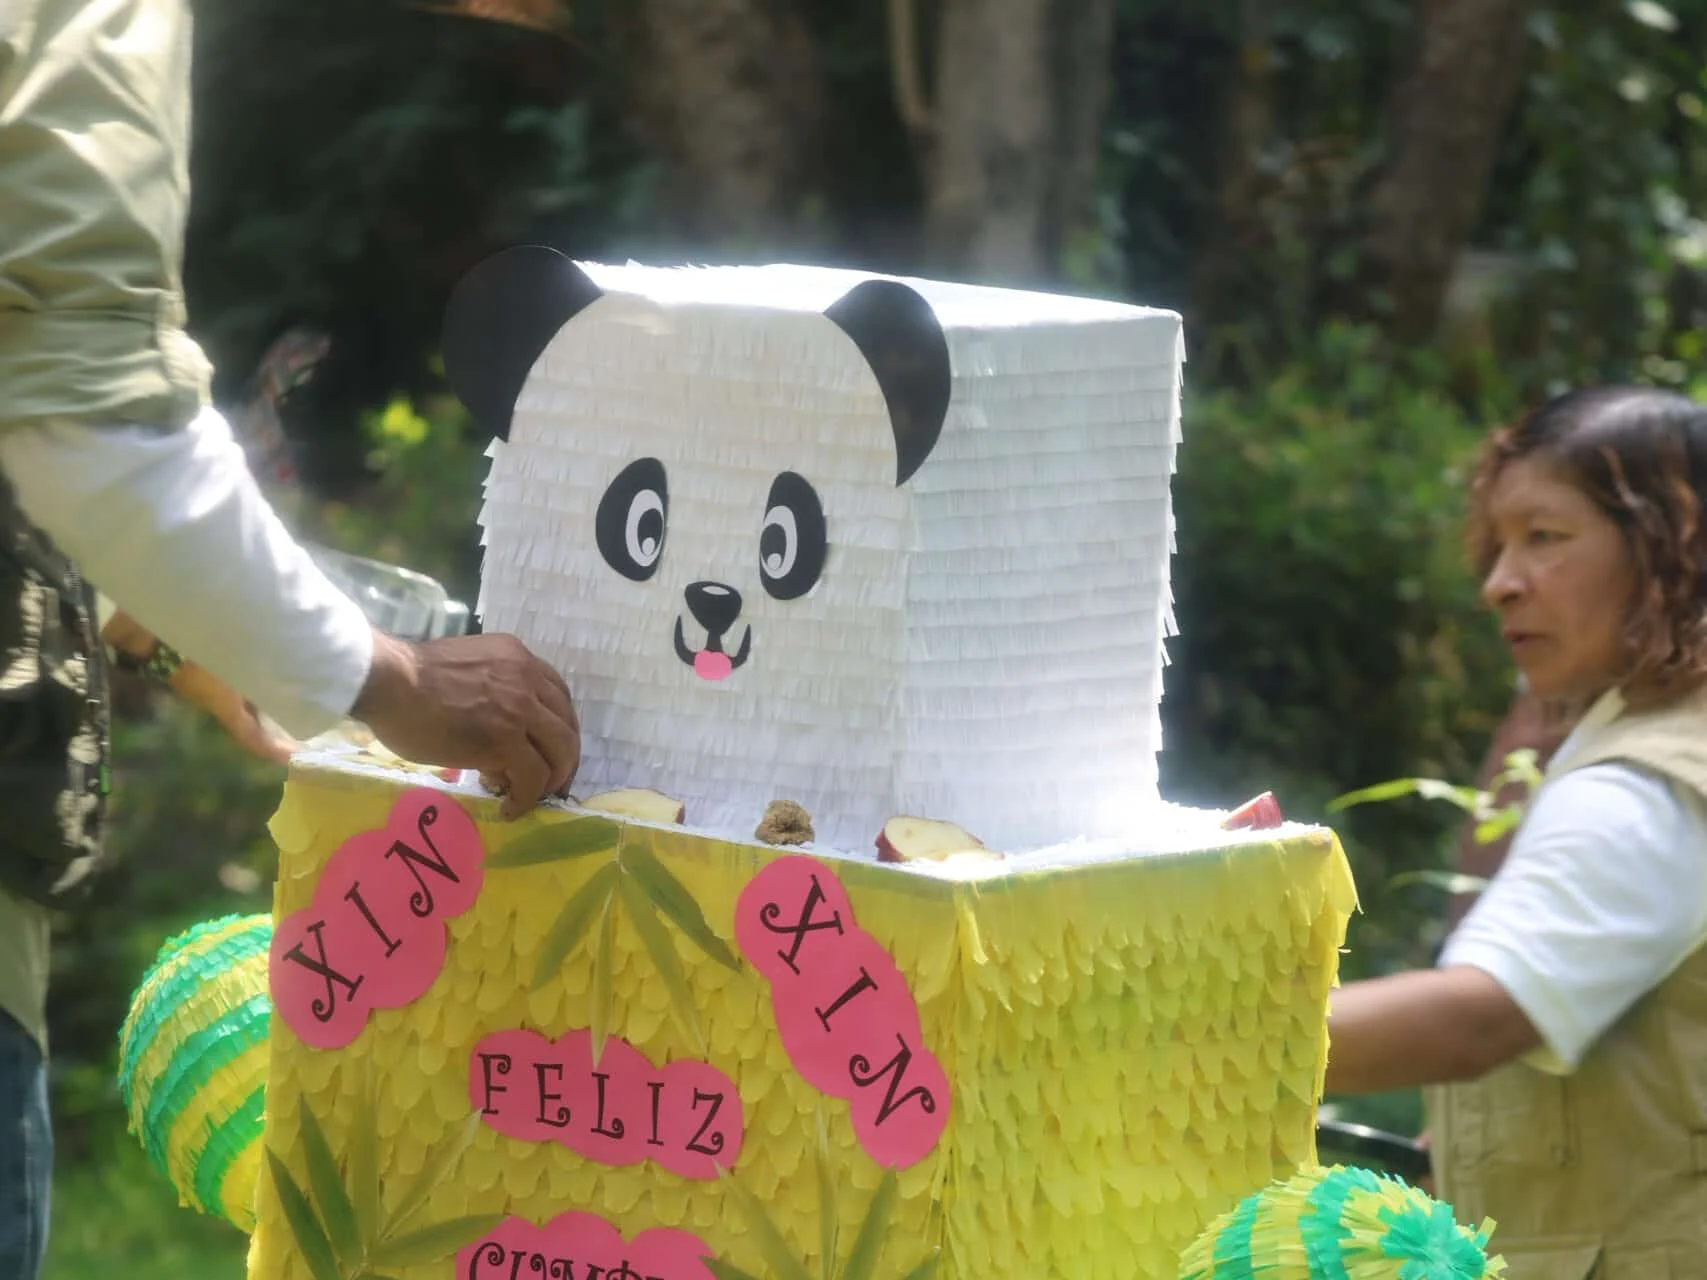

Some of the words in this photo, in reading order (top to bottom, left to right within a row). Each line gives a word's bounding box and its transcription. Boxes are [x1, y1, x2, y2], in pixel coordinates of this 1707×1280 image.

[283, 804, 462, 1023] XIN
[759, 873, 937, 1128] XIN
[477, 1052, 725, 1157] FELIZ
